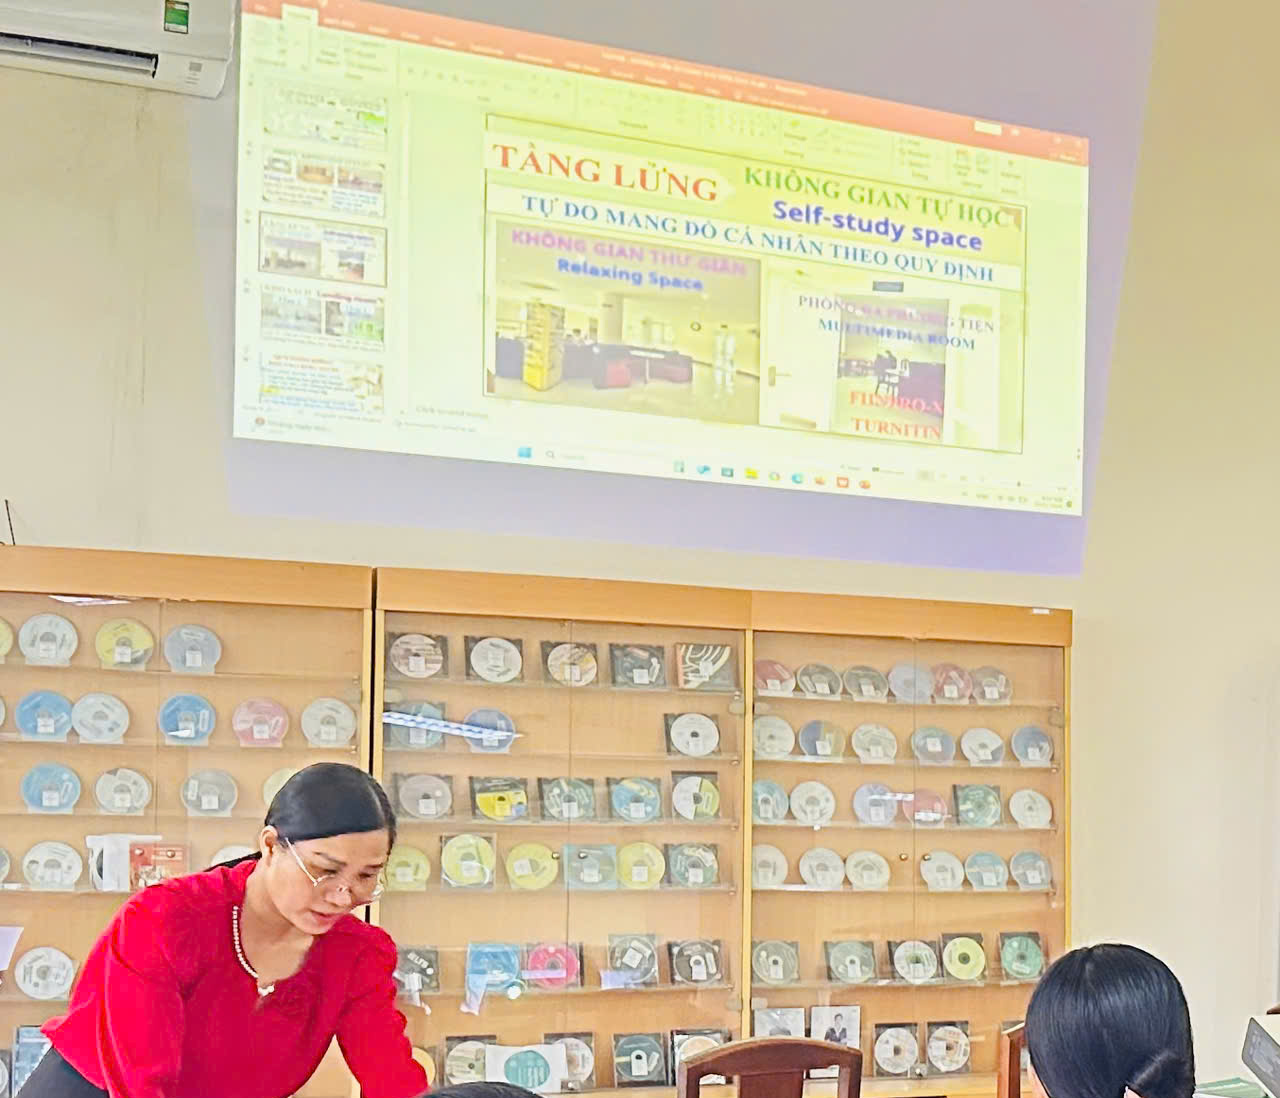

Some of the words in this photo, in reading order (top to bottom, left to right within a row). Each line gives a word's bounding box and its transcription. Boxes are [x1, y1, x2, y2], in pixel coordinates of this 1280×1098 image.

[745, 166, 840, 200] KHÔNG
[848, 185, 910, 211] GIAN
[564, 201, 598, 222] DO
[606, 208, 677, 234] MANG
[760, 233, 824, 257] NHÂN
[829, 242, 889, 267] THEO
[895, 252, 939, 274] QUY
[773, 200, 905, 243] Self-study
[912, 225, 983, 250] space
[557, 257, 644, 286] Relaxing
[648, 269, 704, 291] Space
[853, 418, 942, 440] TURNITIN
